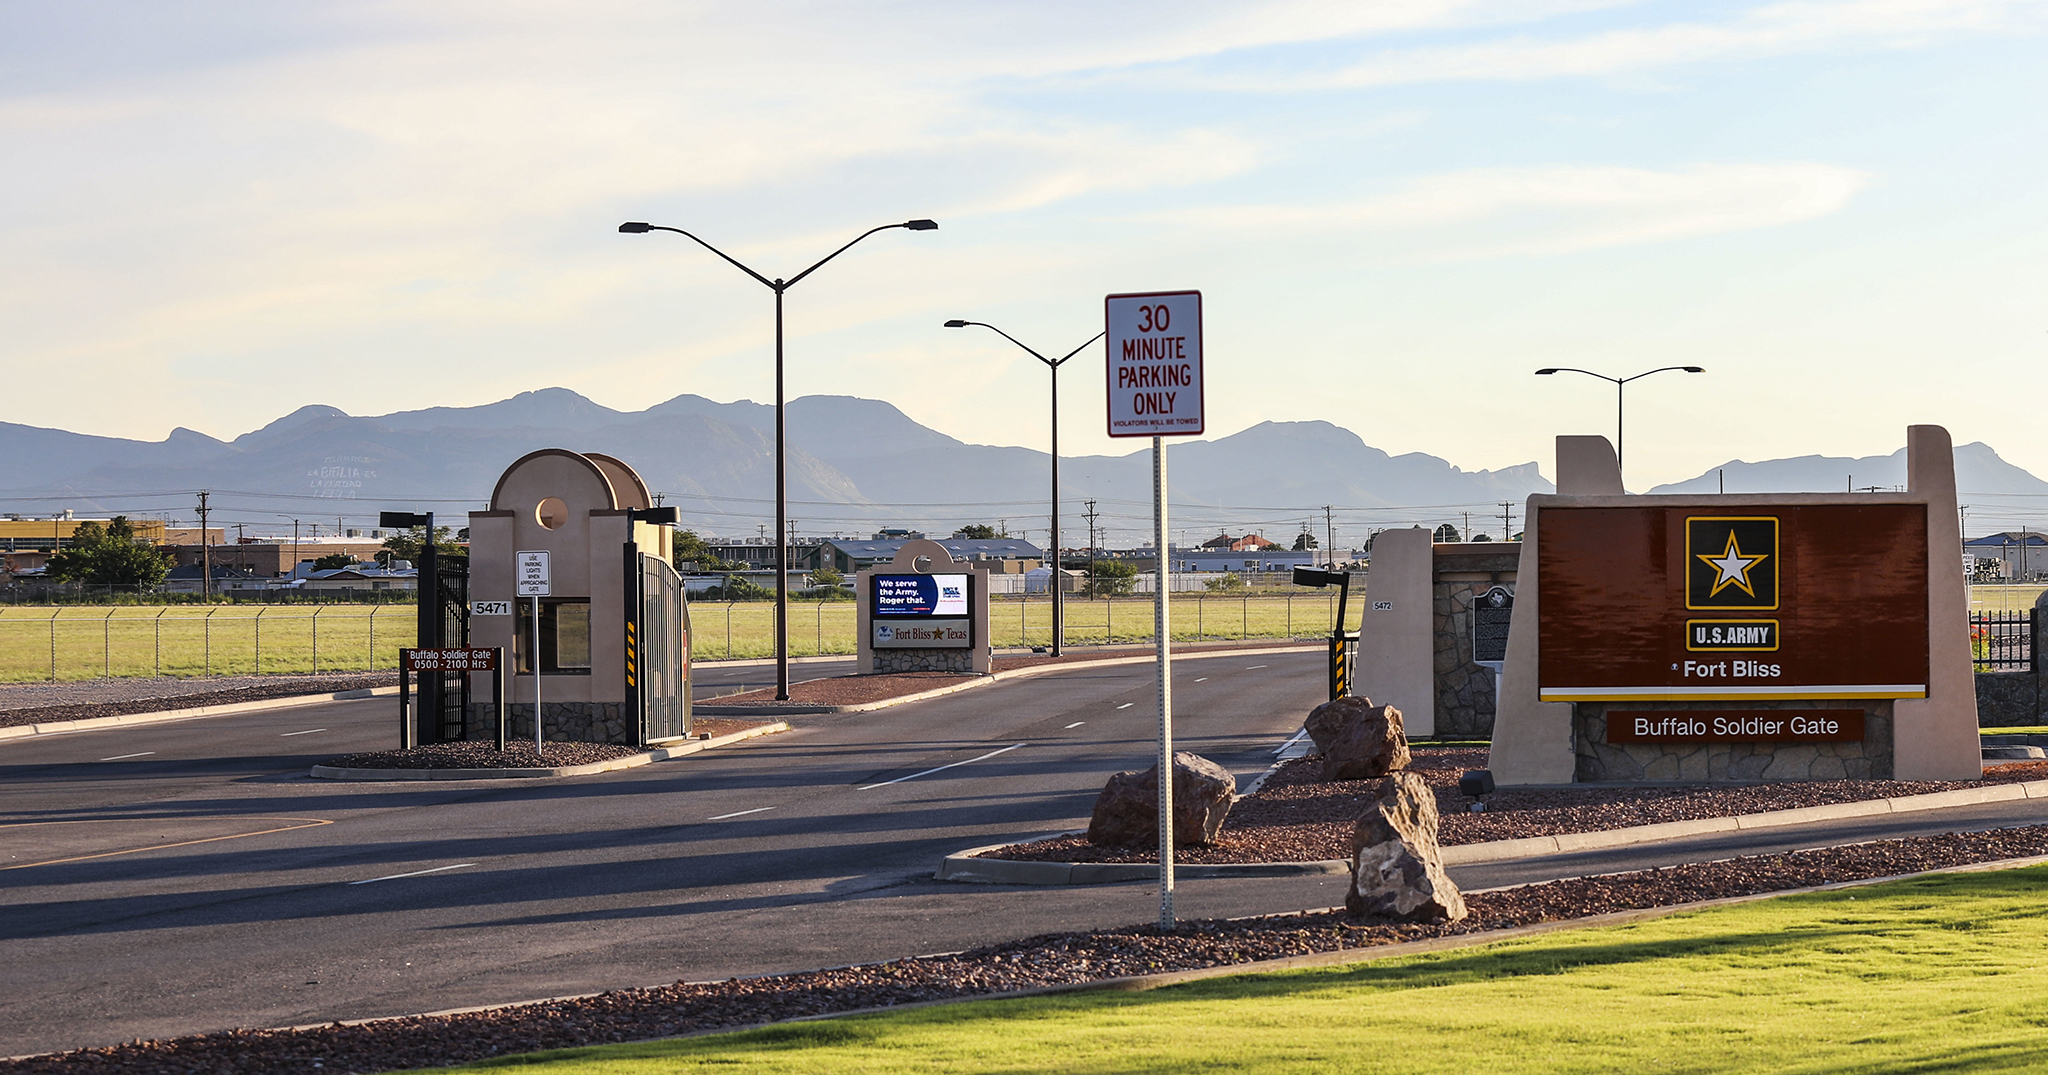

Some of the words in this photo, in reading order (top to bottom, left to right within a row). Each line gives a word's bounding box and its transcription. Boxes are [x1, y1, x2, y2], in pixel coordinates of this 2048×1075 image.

[1138, 304, 1170, 333] 30
[1122, 336, 1186, 361] MINUTE
[1118, 363, 1191, 389] PARKING
[1134, 391, 1177, 415] ONLY
[1113, 419, 1149, 427] VIOLATORS
[1166, 418, 1175, 426] BE
[320, 465, 361, 478] BIBLIA
[364, 470, 377, 478] ES
[879, 588, 894, 596] the
[895, 588, 919, 597] Army.
[879, 596, 905, 605] Roger
[906, 596, 926, 604] that.
[1374, 602, 1392, 610] 5472
[476, 602, 507, 614] 5471
[895, 627, 911, 640] Fort
[912, 627, 931, 640] Bliss
[946, 627, 967, 639] Texas
[1696, 627, 1769, 644] U.S.ARMY
[409, 650, 439, 660] Buffalo
[441, 649, 469, 659] Soldier
[472, 650, 491, 659] Gate
[414, 660, 438, 669] 0500
[446, 660, 468, 669] 2100
[471, 660, 487, 669] Hrs
[1684, 660, 1727, 677] Fort
[1733, 660, 1781, 677] Bliss
[1634, 717, 1707, 736] Buffalo
[1713, 716, 1784, 735] Soldier
[1790, 716, 1839, 735] Gate
